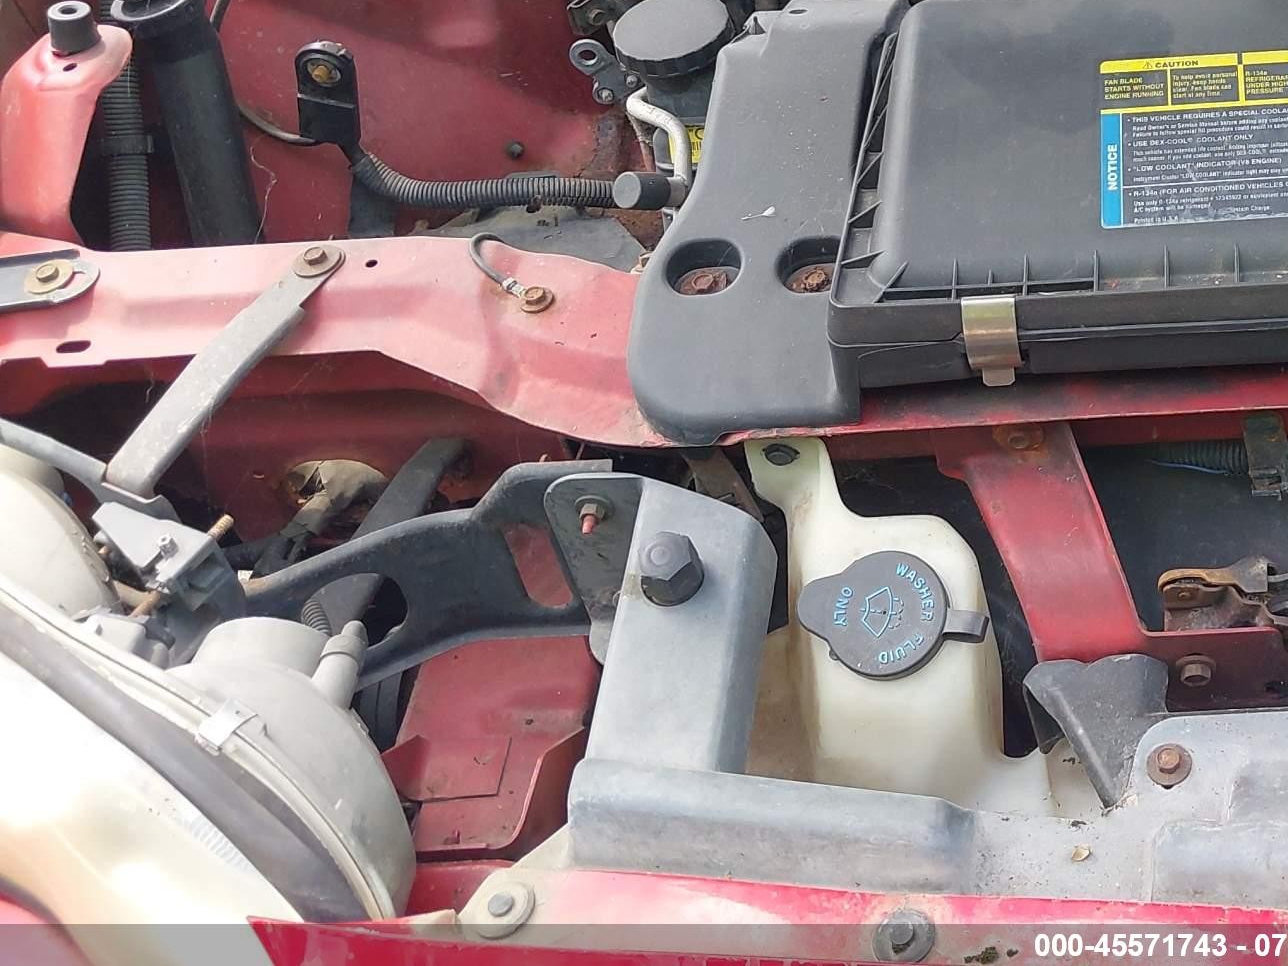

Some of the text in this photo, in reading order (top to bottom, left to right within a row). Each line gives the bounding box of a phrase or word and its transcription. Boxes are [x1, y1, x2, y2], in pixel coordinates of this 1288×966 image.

[1155, 60, 1198, 68] CAUTION
[1107, 144, 1118, 191] NOTICE
[1196, 160, 1235, 168] INDICATOR
[1193, 184, 1245, 192] CONDITIONED
[833, 562, 935, 664] WASHER FLUID ONLY
